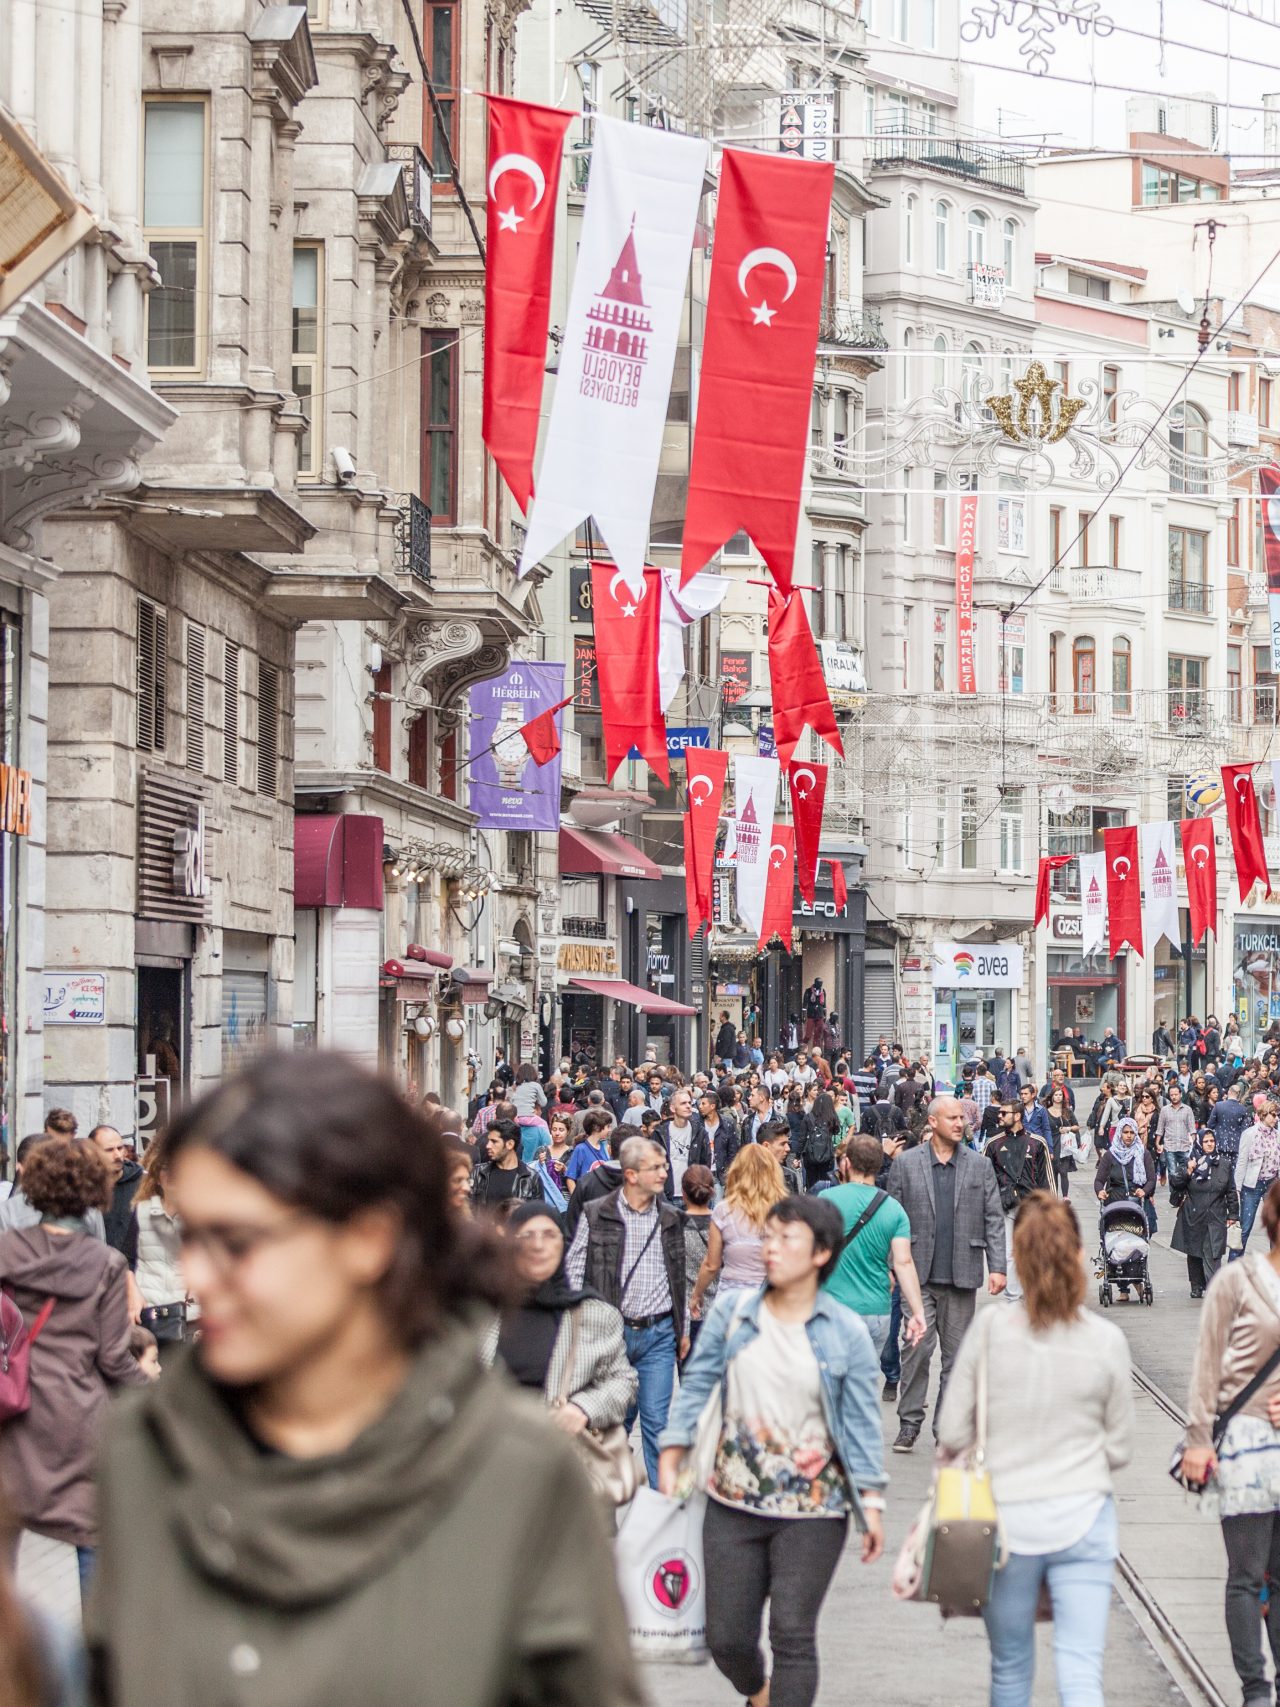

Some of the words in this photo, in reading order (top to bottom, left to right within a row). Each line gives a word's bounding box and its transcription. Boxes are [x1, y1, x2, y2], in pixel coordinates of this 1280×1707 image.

[960, 503, 975, 556] KANADA
[665, 736, 704, 750] KCELL
[1058, 915, 1084, 936] ÖZSÜ
[978, 956, 1008, 976] avea
